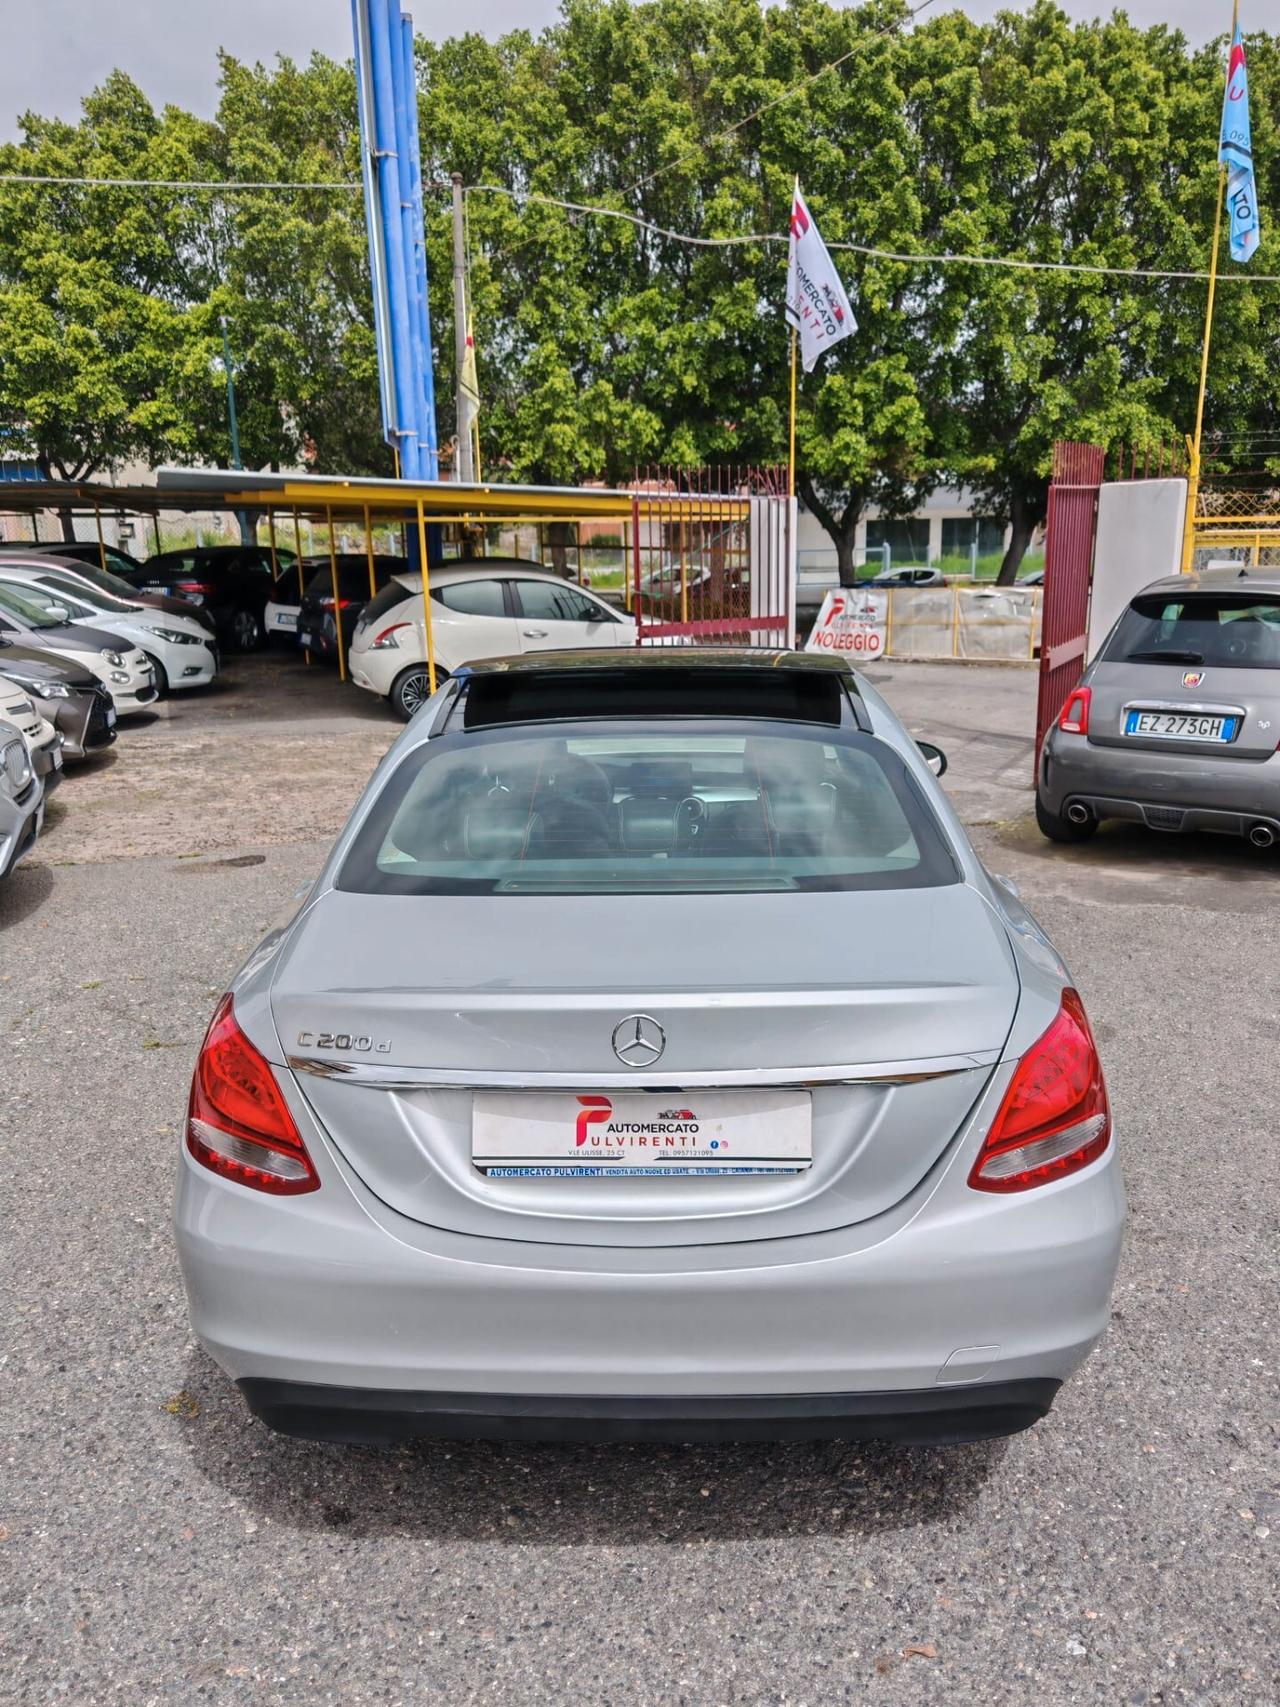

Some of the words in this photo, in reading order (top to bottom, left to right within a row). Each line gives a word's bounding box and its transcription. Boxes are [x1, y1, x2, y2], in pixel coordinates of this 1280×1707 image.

[796, 261, 837, 336] OMERCATO
[813, 631, 880, 651] NOLEGGIO
[607, 1123, 699, 1133] AUTOMERCATO
[490, 1168, 552, 1176] AUTOMERCATO
[554, 1168, 604, 1176] PULVIRENTI
